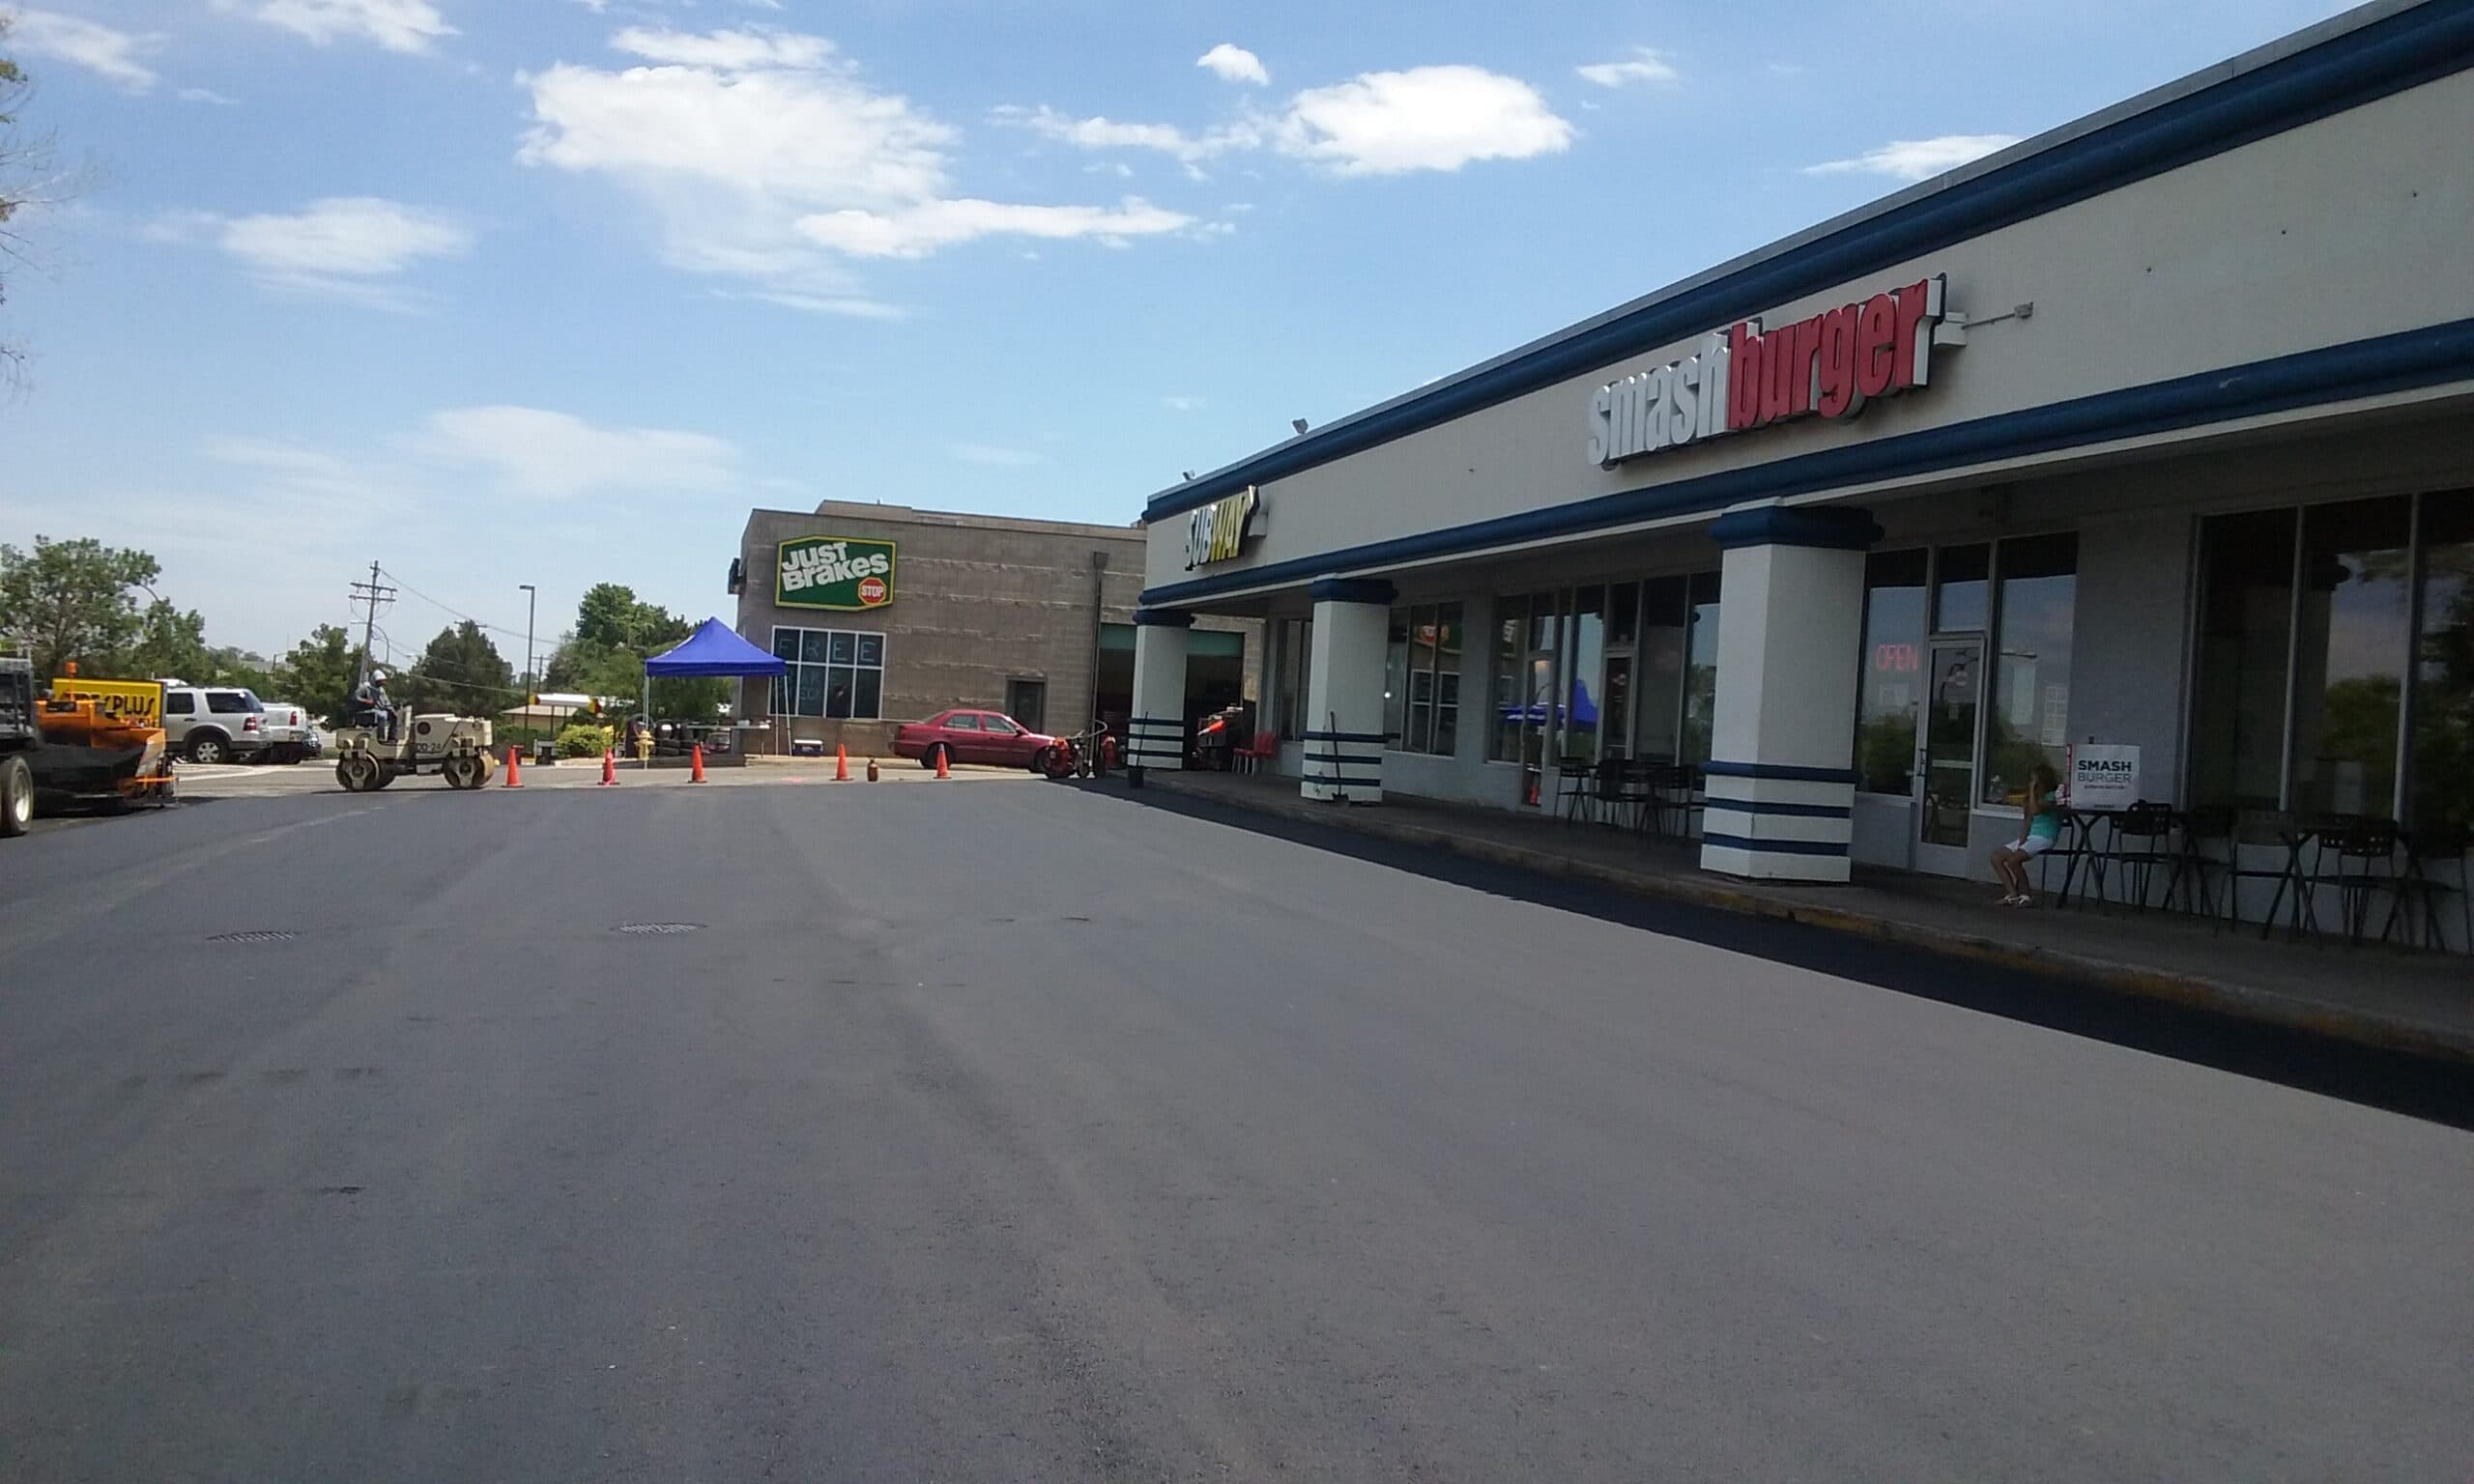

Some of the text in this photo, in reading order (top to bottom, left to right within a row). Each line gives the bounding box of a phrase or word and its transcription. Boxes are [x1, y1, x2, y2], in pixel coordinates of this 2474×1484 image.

[1185, 486, 1258, 567] SUBWAY
[782, 554, 889, 592] Brakes
[861, 585, 884, 597] STOP
[778, 639, 877, 663] FREE
[1876, 644, 1918, 670] OPEN
[113, 695, 156, 716] PLUS
[2078, 759, 2133, 772] SMASH
[2078, 772, 2132, 784] BURGER
